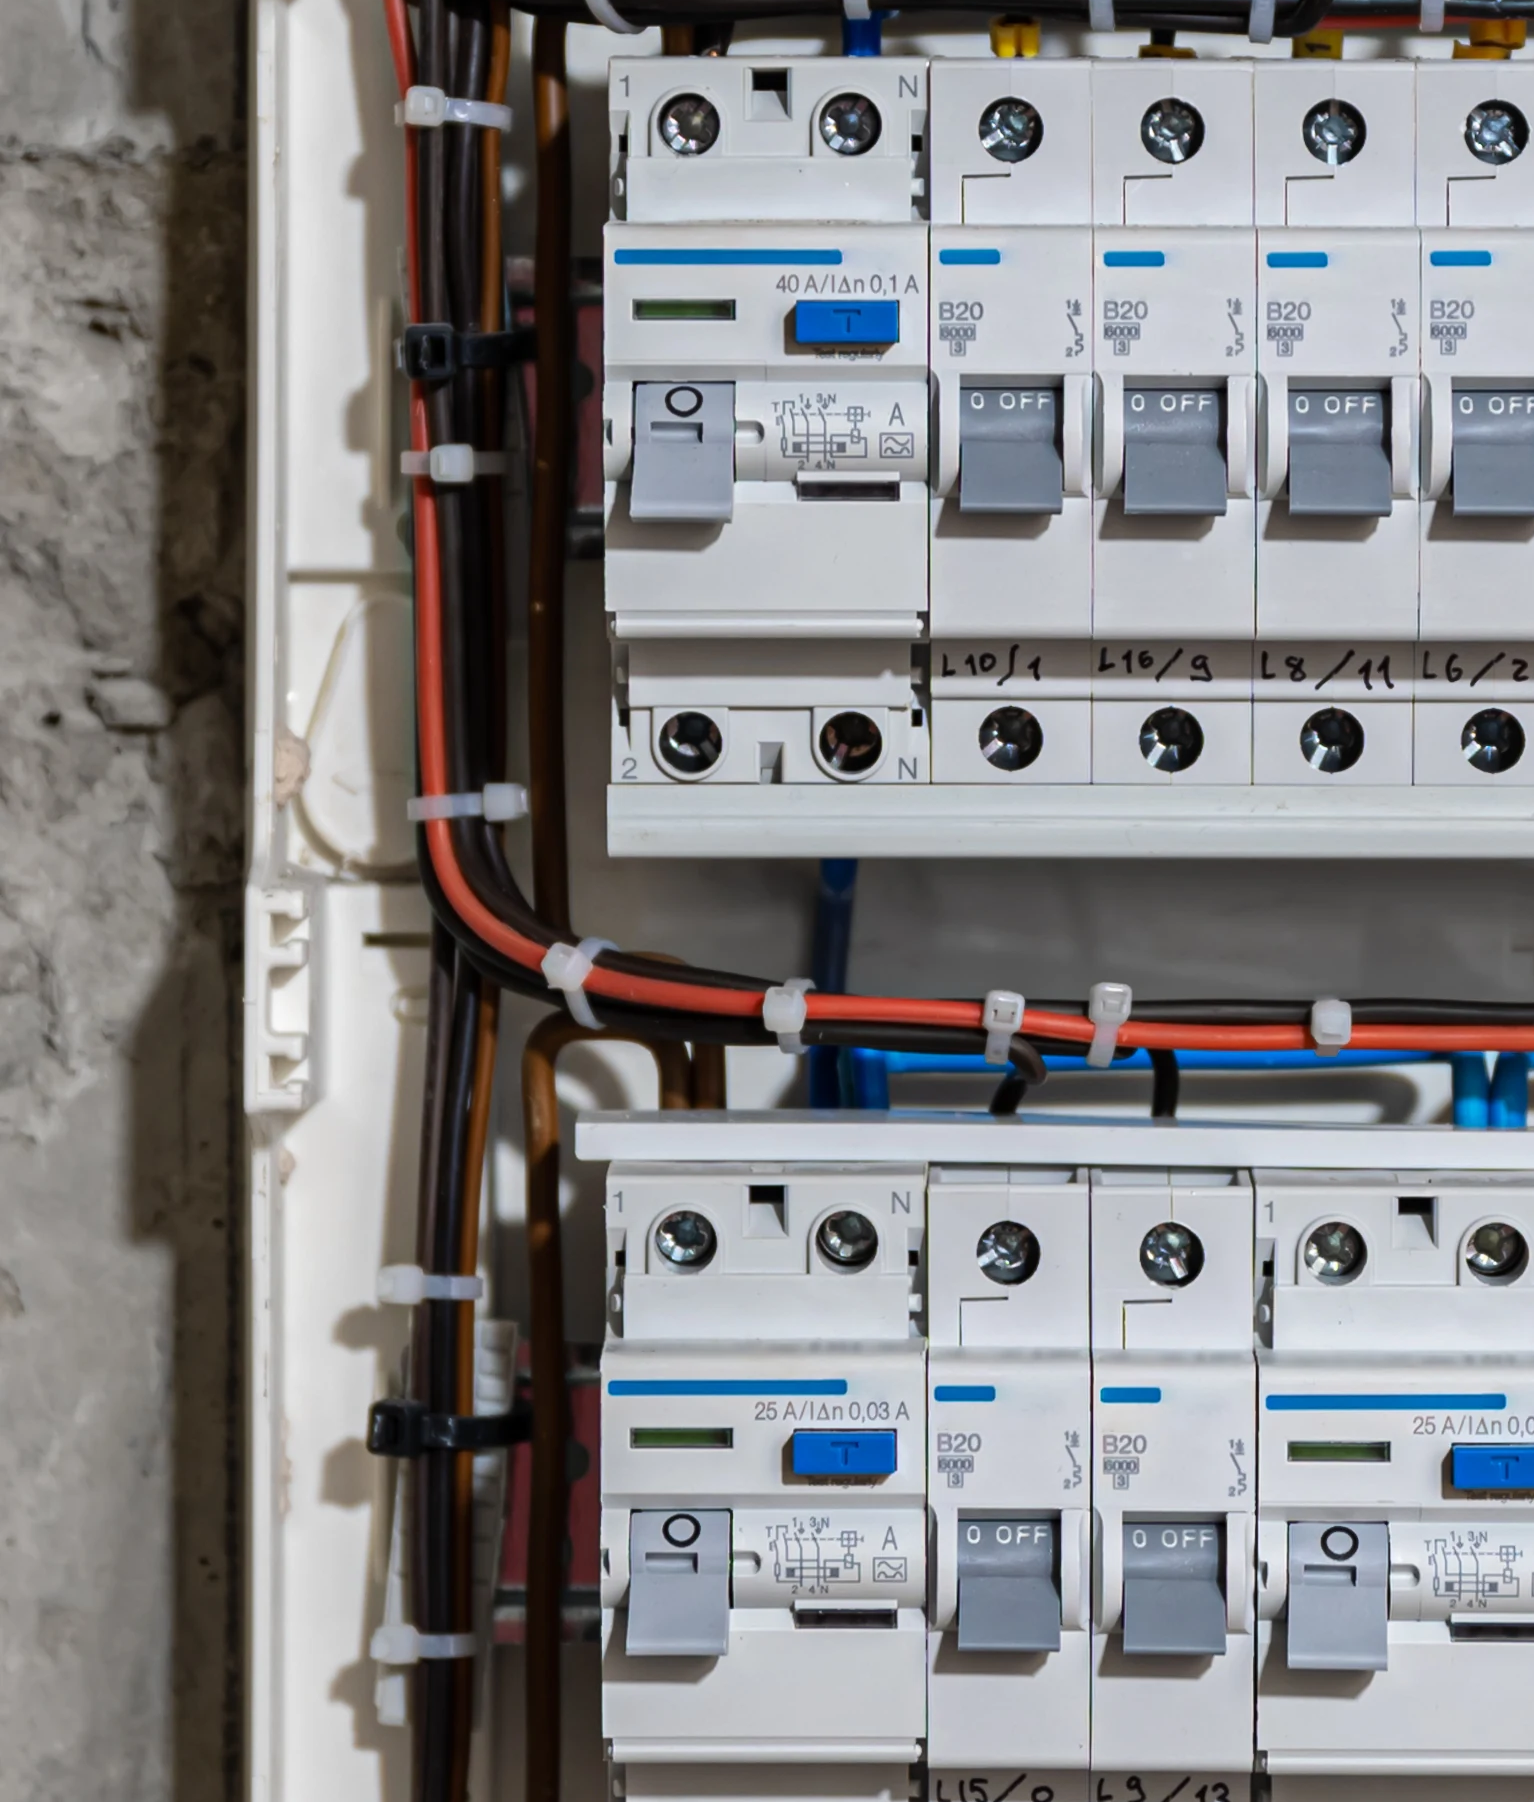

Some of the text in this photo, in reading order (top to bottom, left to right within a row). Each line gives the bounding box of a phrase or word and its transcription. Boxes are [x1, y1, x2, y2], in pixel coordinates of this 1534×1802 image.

[619, 75, 630, 98] 1
[899, 75, 918, 99] N
[775, 275, 800, 295] 40
[904, 275, 920, 295] A
[938, 301, 984, 321] B20
[1104, 300, 1149, 320] B20
[1267, 302, 1312, 321] B20
[1430, 300, 1475, 320] B20
[999, 392, 1052, 410] OFF
[1160, 394, 1214, 412] OFF
[1324, 396, 1377, 414] OFF
[621, 758, 638, 780] 2
[898, 758, 918, 780] N
[612, 1190, 624, 1213] 1
[891, 1191, 911, 1214] N
[1263, 1201, 1275, 1223] 1
[754, 1401, 778, 1421] 25
[848, 1401, 891, 1423] 0,03
[895, 1402, 910, 1421] A
[1412, 1415, 1436, 1435] 25
[937, 1433, 982, 1453] B20
[1102, 1435, 1147, 1454] B20
[995, 1526, 1049, 1545] OFF
[1161, 1529, 1214, 1548] OFF
